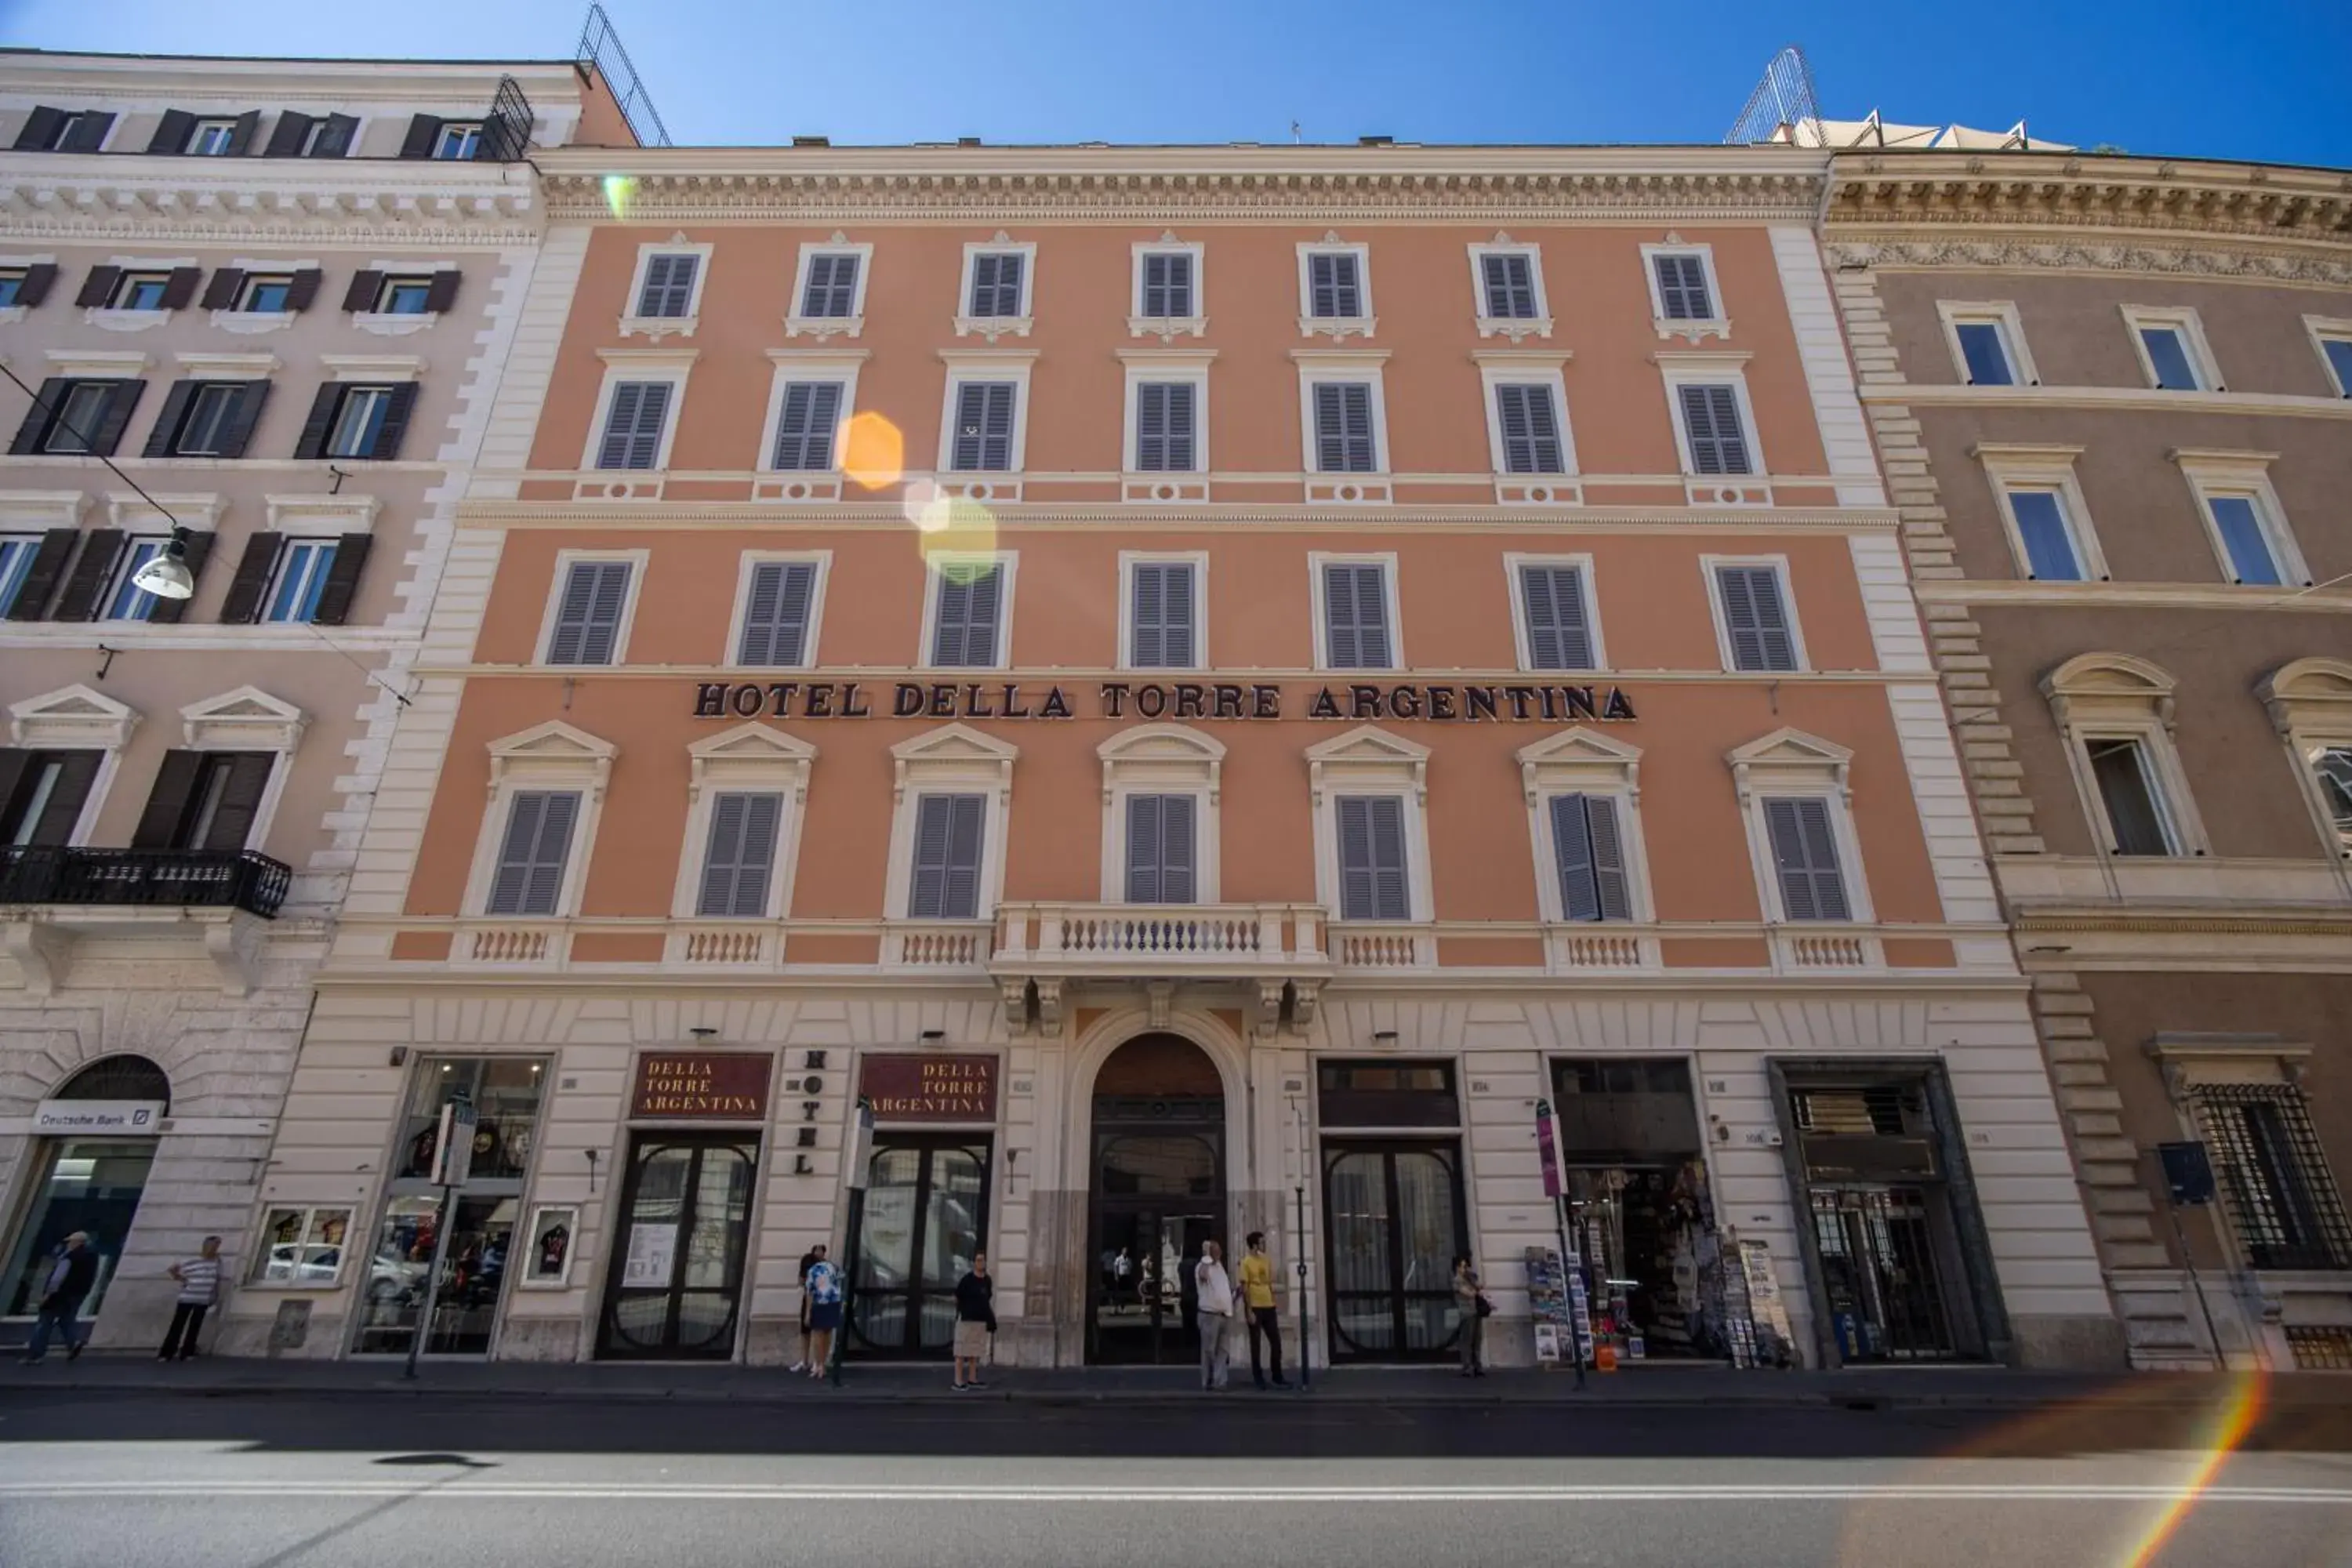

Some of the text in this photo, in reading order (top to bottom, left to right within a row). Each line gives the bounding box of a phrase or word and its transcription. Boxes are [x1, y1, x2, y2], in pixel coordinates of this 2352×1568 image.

[693, 684, 1638, 721] HOTEL DELLA TORRE ARGENTINA
[648, 1062, 712, 1076] DELLA
[924, 1064, 987, 1077] DELLA
[645, 1079, 711, 1092] TORRE
[923, 1081, 987, 1094] TORRE
[643, 1096, 757, 1111] ARGENTINA
[870, 1098, 985, 1112] ARGENTINA
[795, 1050, 827, 1174] HOTEL
[41, 1114, 126, 1125] Deutsche Bank
